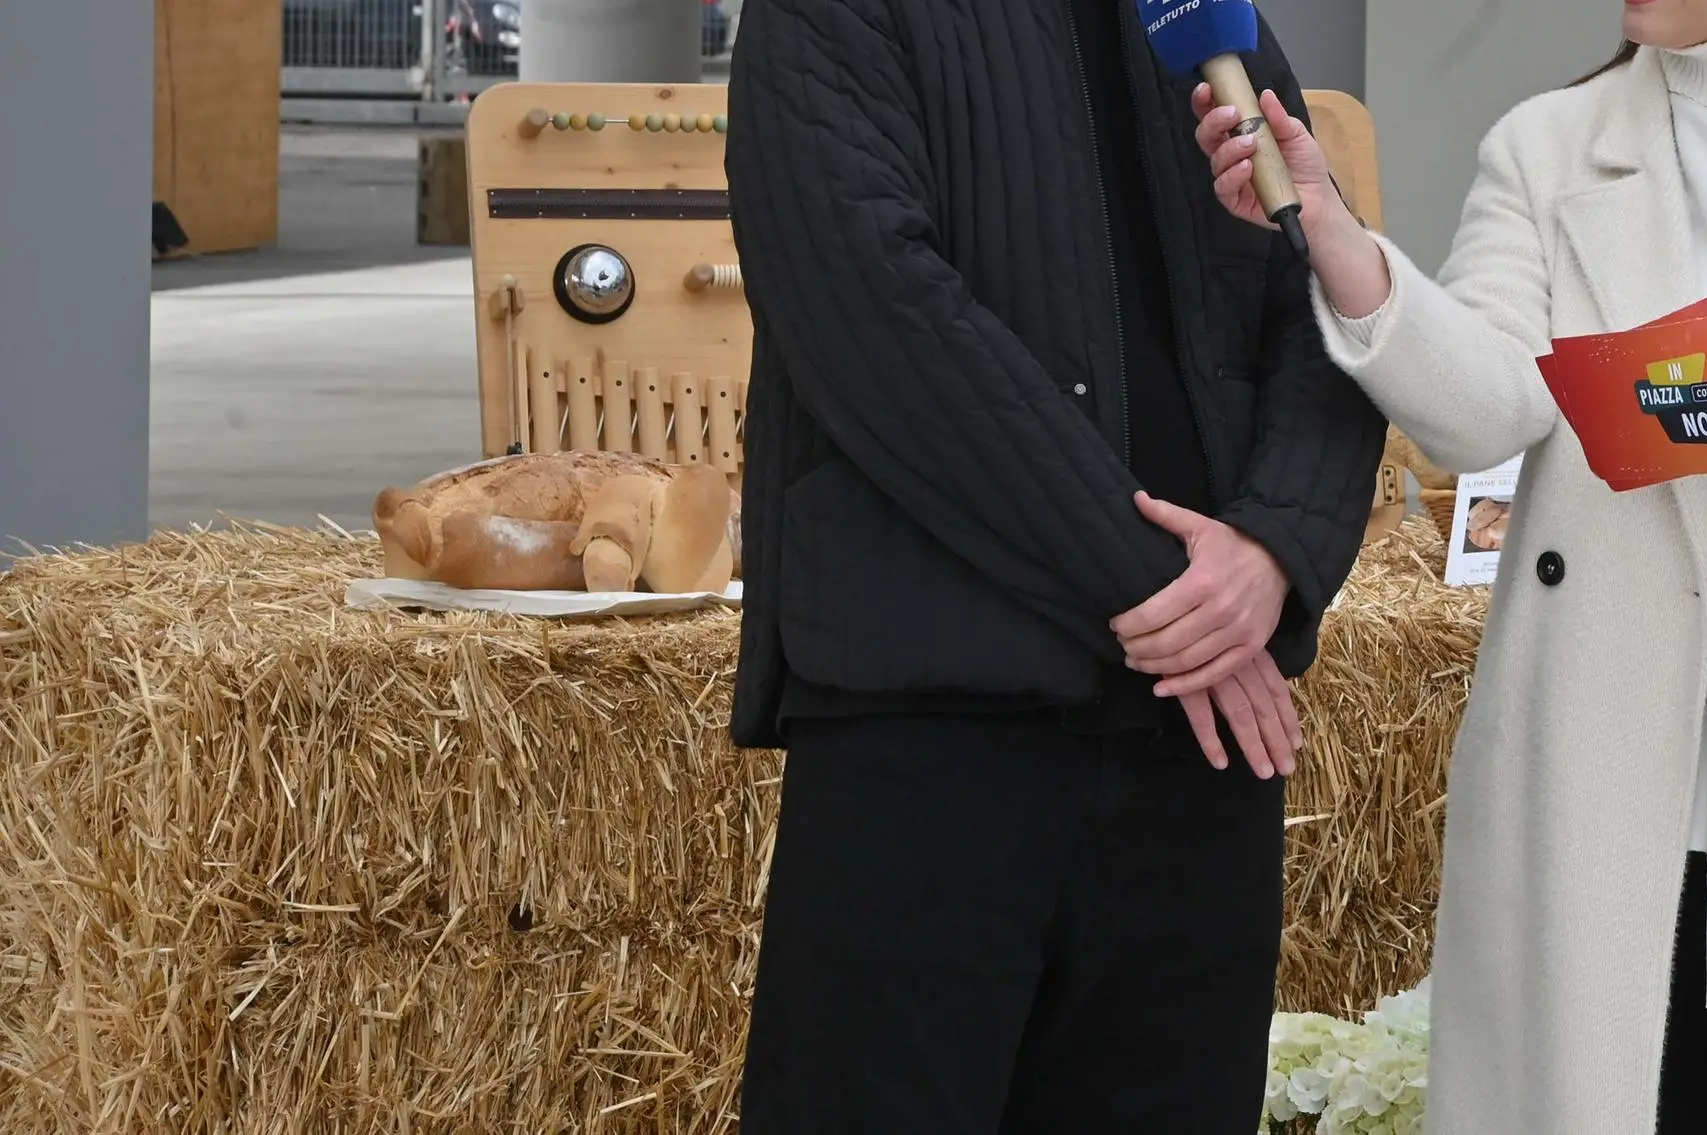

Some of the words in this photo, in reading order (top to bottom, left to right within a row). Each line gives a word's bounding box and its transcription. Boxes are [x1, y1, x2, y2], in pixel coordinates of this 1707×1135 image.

[1147, 0, 1200, 35] TELETUTTO
[1668, 362, 1682, 381] IN
[1640, 387, 1684, 405] PIAZZA
